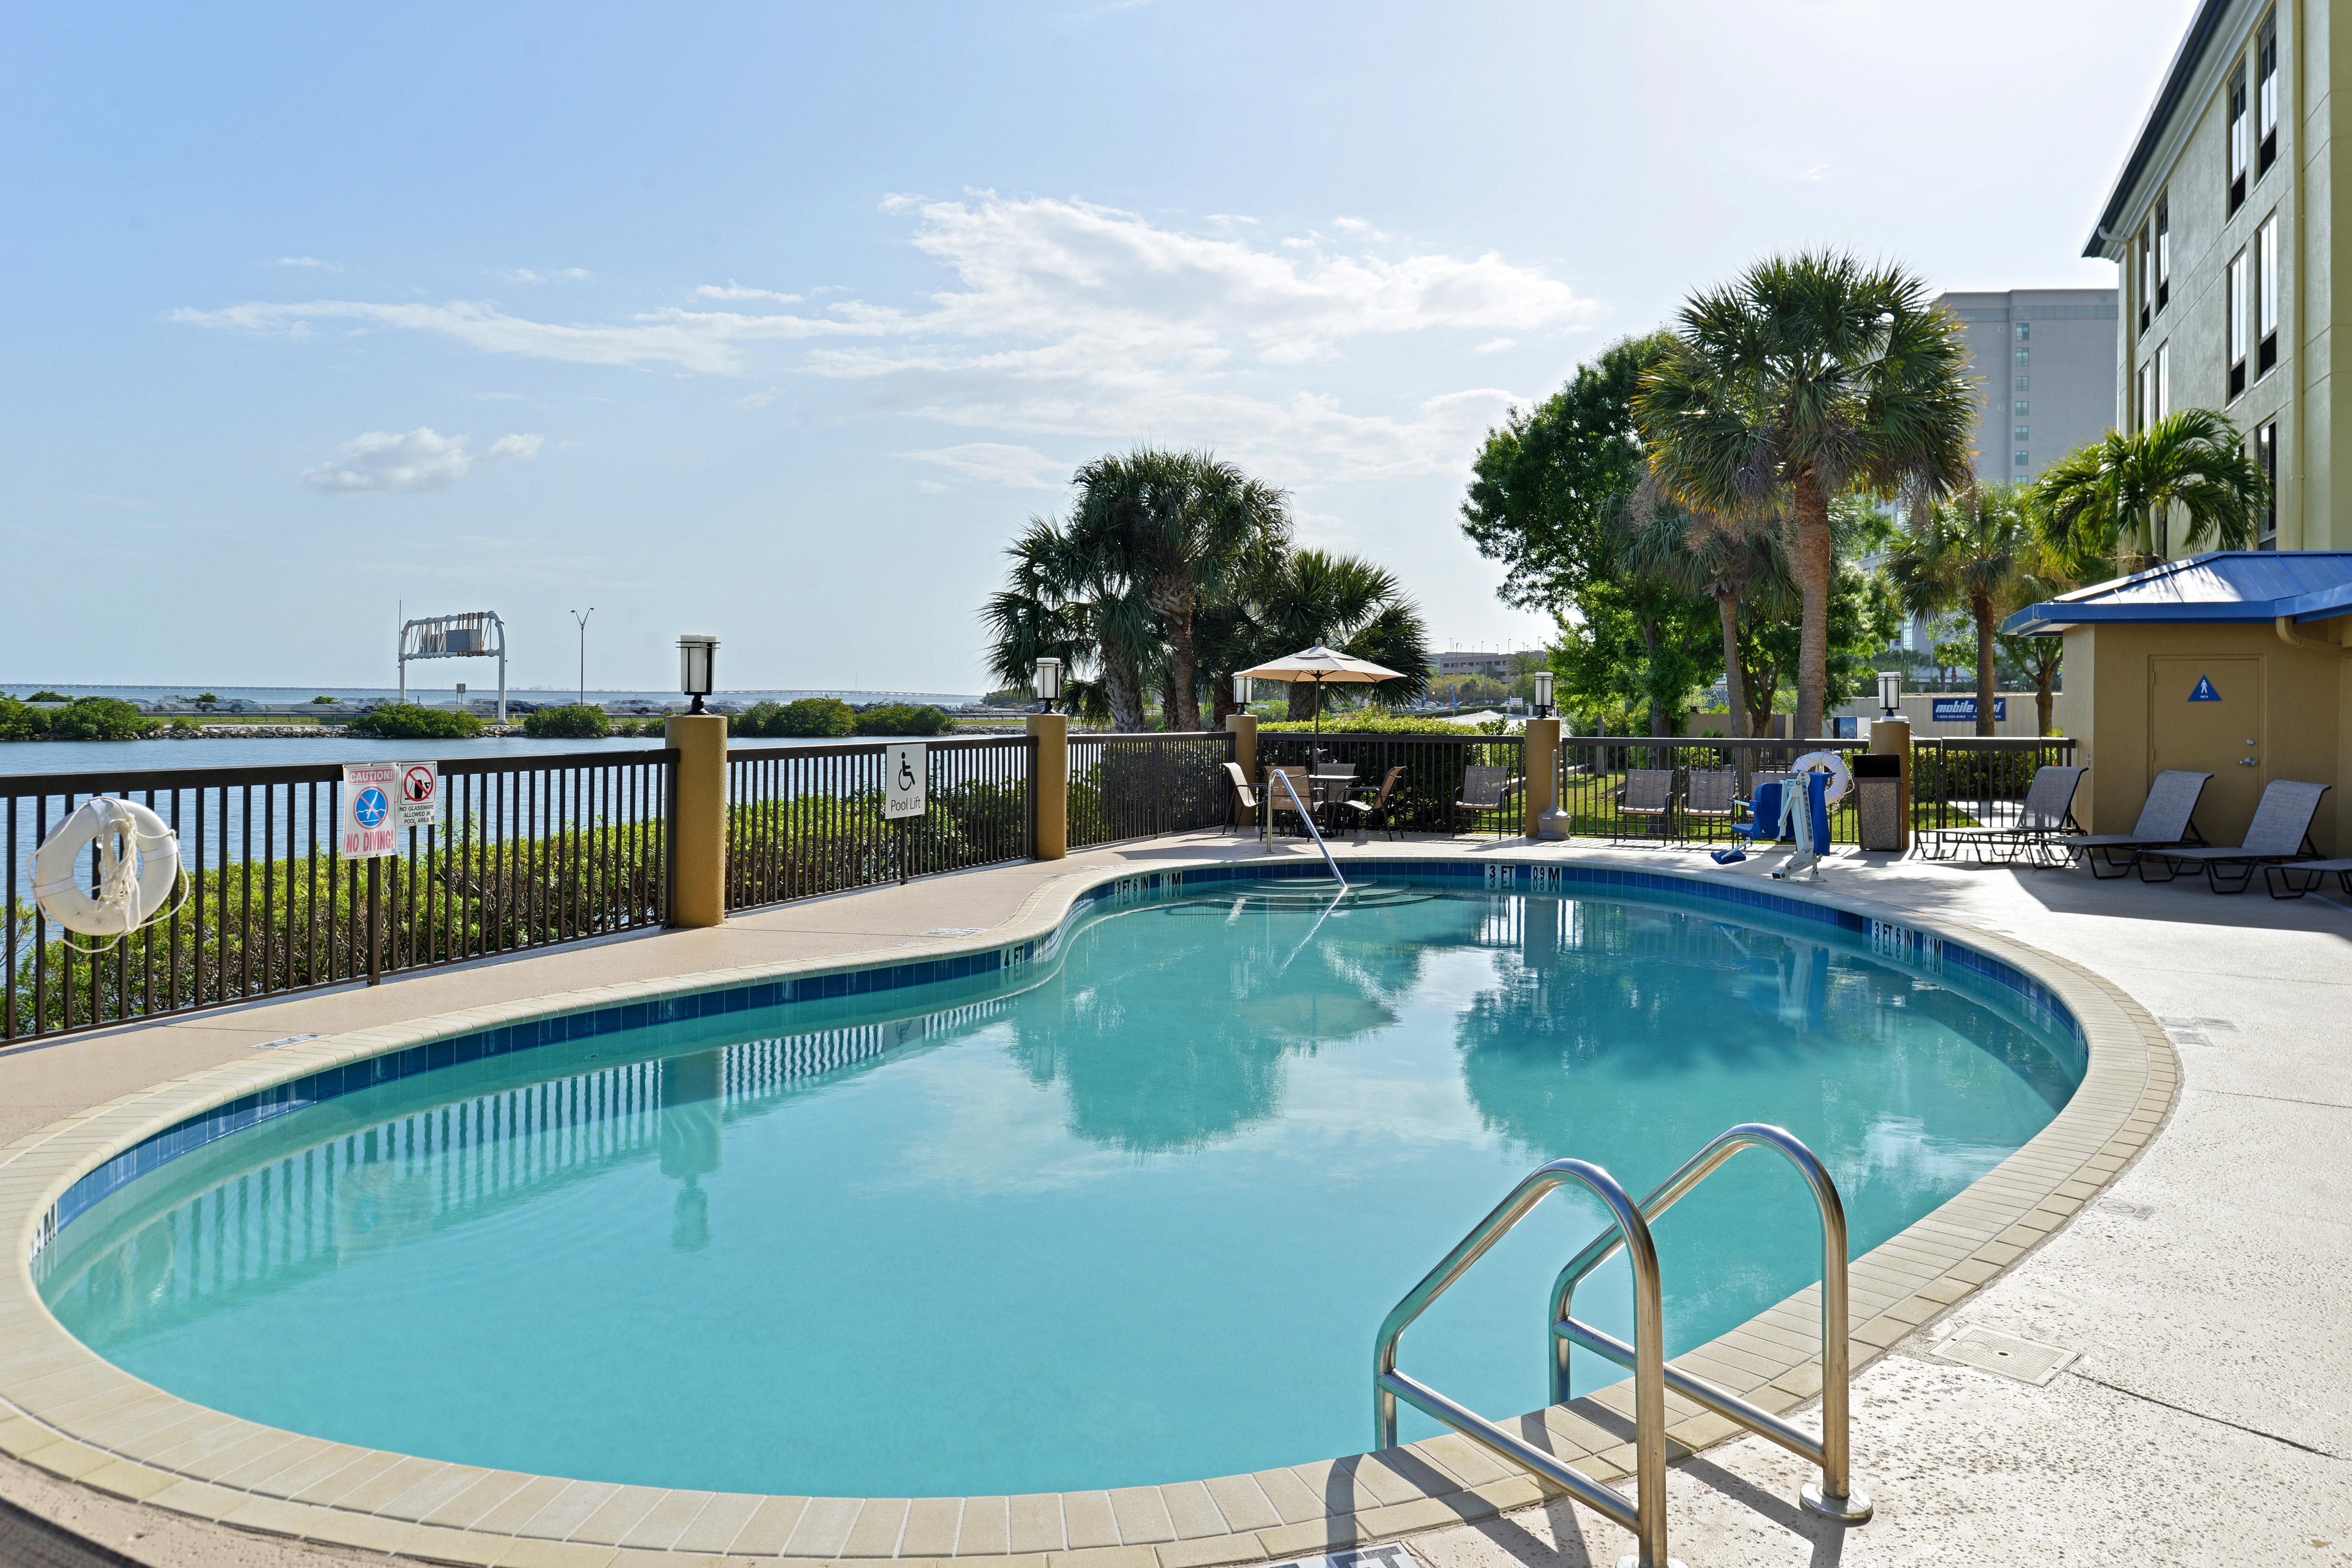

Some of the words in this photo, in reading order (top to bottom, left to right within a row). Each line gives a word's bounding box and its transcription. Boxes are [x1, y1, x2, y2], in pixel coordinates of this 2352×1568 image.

[1935, 700, 1973, 712] mobile
[349, 770, 393, 782] CAUTION!
[891, 798, 908, 812] Pool
[910, 796, 921, 810] Lift
[346, 833, 359, 853] NO
[363, 830, 393, 851] DIVING!
[1172, 872, 1181, 886] M
[1489, 865, 1496, 878] 3
[1501, 865, 1515, 879] FT
[1533, 866, 1545, 880] 0.9
[1548, 867, 1560, 881] M
[1117, 882, 1121, 894] 3
[1123, 879, 1131, 893] FT
[1133, 878, 1137, 891] 6
[1141, 876, 1149, 890] IN
[1875, 921, 1879, 938] 3
[1883, 923, 1893, 941] FT
[1896, 927, 1901, 944] 6
[1904, 928, 1913, 948] IN
[1004, 949, 1010, 967] 4
[1014, 945, 1024, 965] FT
[1934, 938, 1942, 958] M
